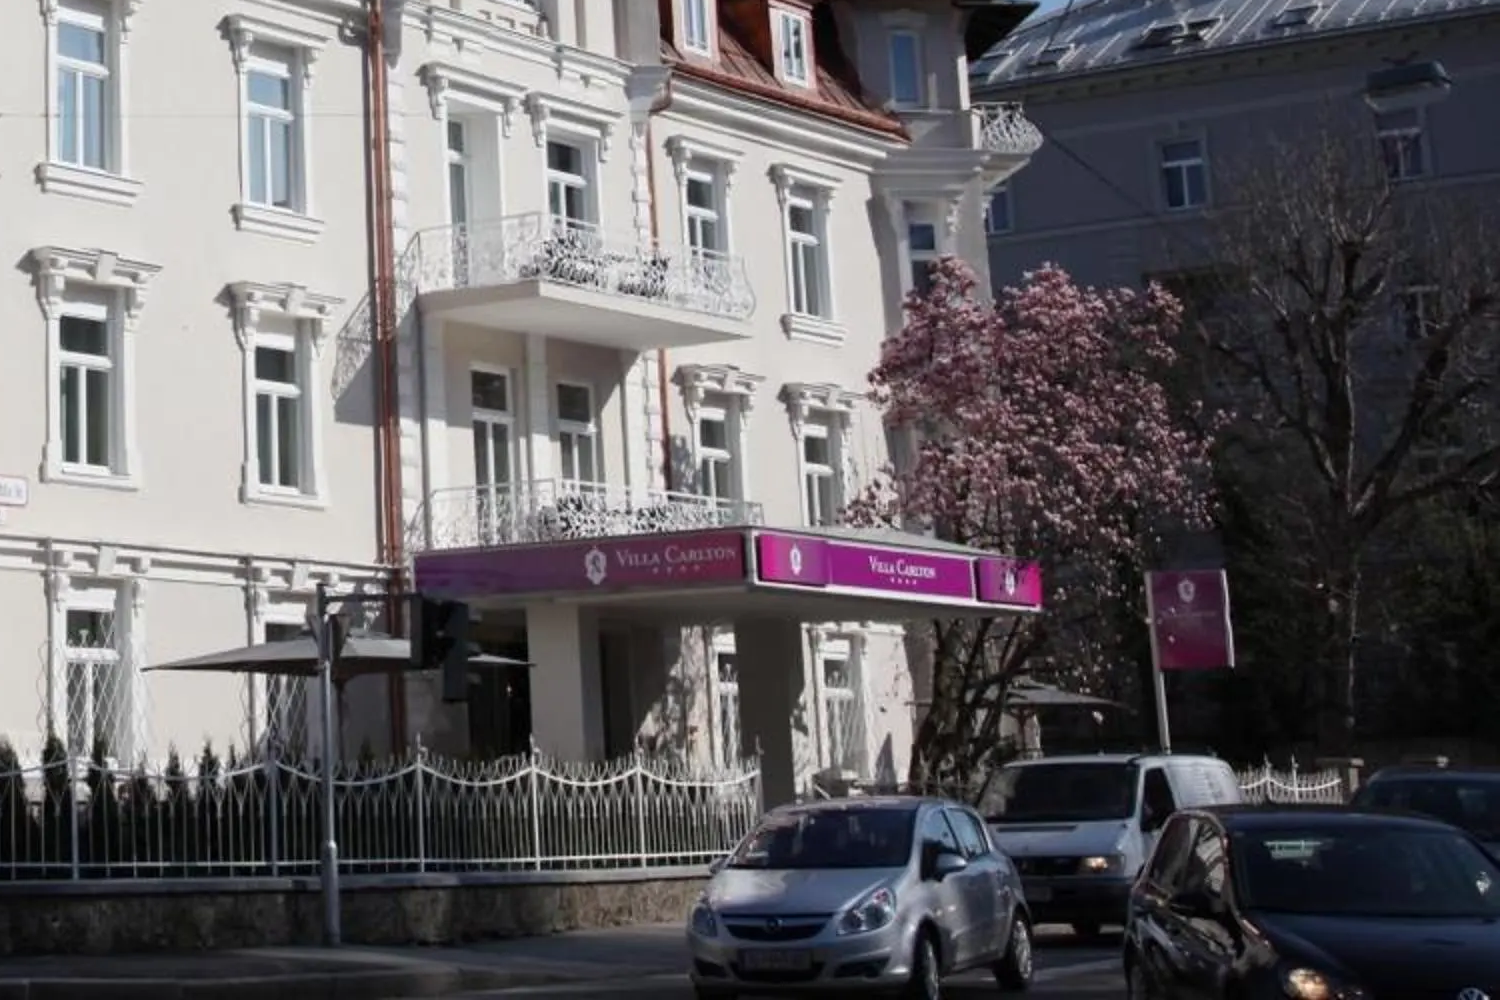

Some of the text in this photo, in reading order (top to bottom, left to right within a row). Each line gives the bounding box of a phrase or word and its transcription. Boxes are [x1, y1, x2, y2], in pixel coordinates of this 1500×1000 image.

[615, 545, 737, 567] VILLA CARLTON
[868, 555, 894, 573] VILLA
